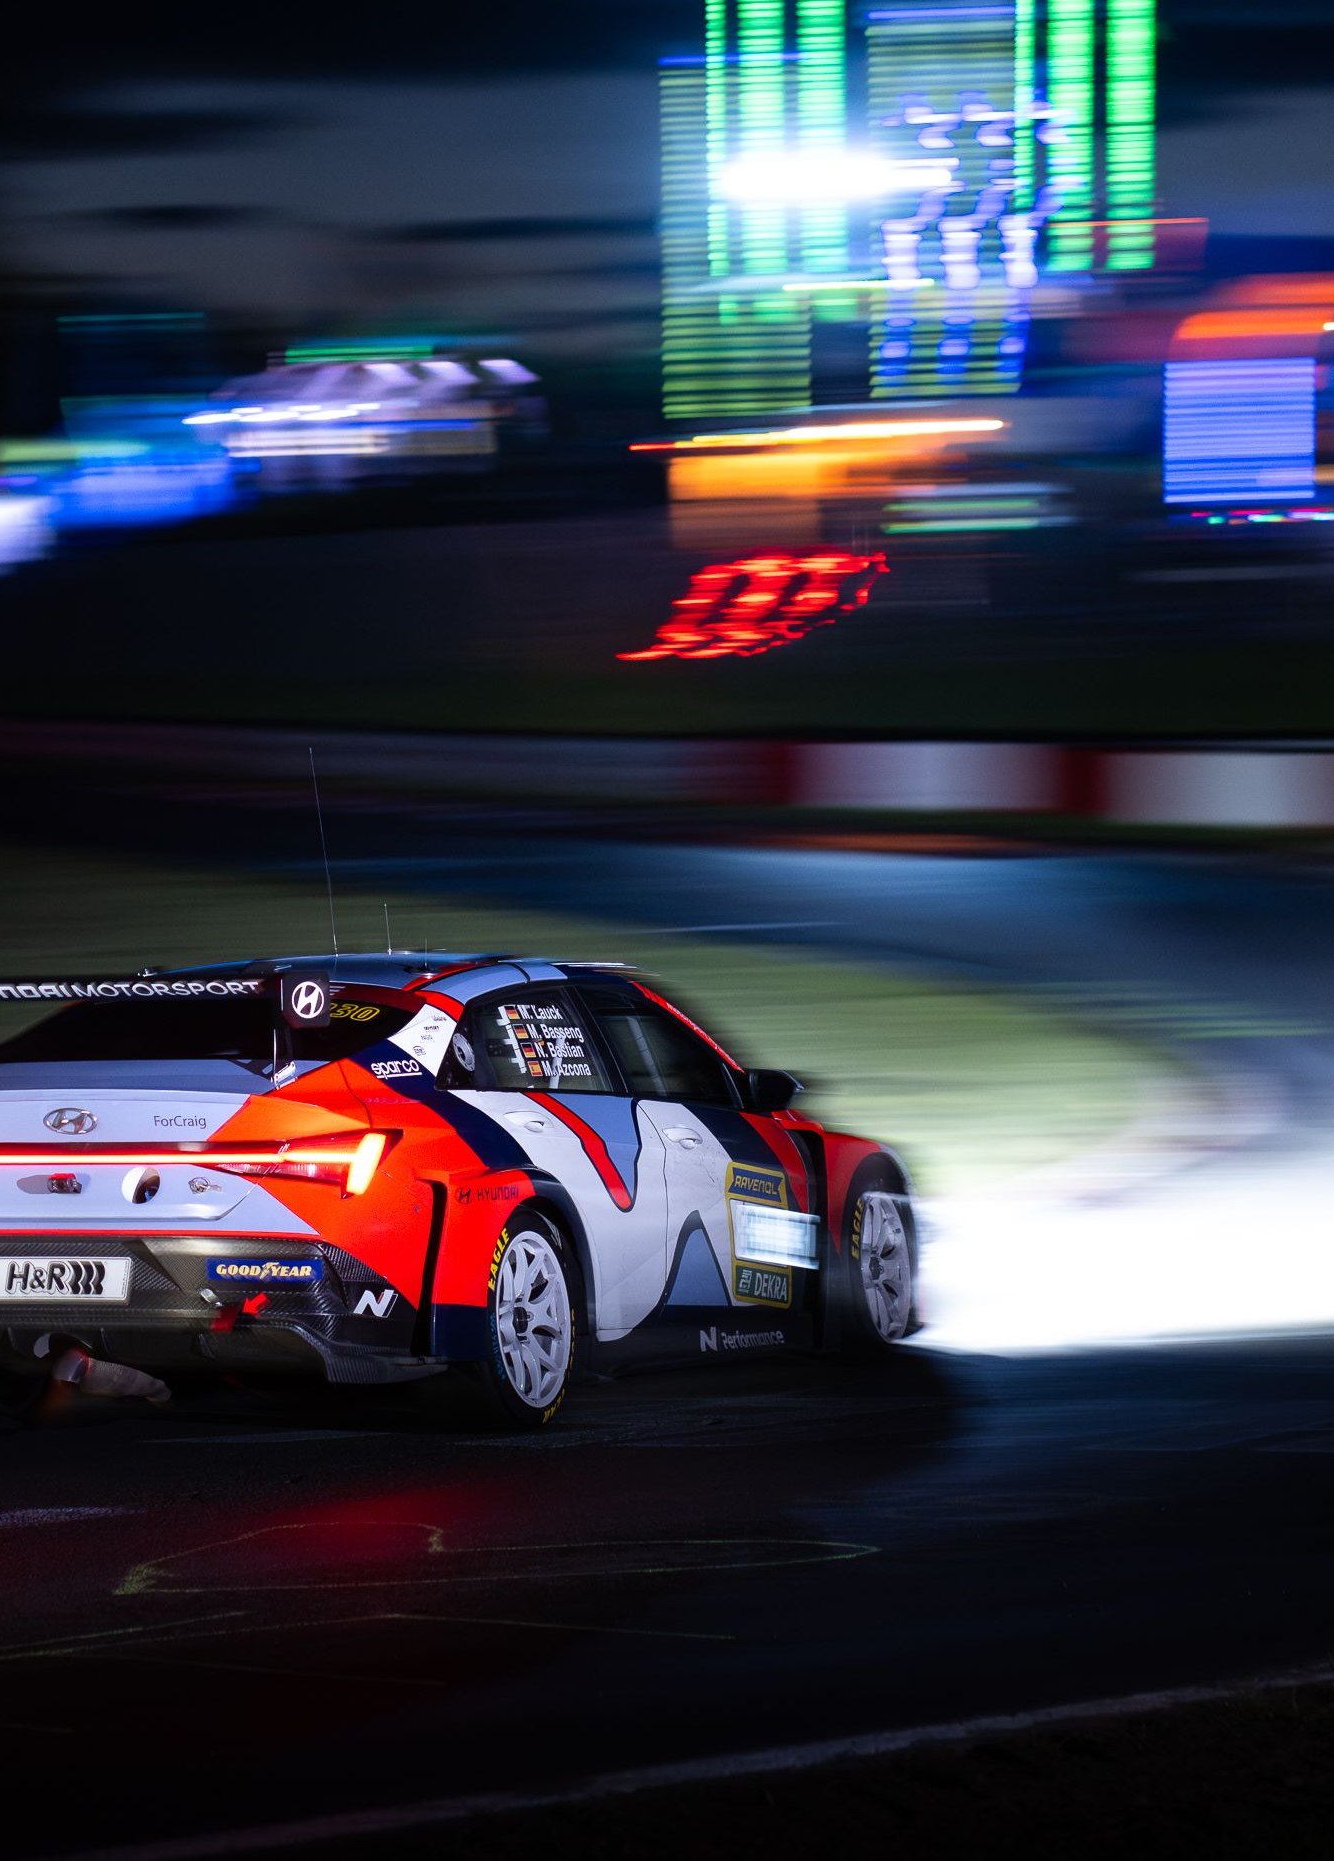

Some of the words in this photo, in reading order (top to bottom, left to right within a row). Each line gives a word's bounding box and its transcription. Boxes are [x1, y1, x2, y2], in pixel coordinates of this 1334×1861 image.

[71, 980, 259, 997] MOTORSPORT
[329, 1003, 381, 1021] 30
[516, 1004, 533, 1019] M.
[531, 1004, 563, 1019] Lauck
[526, 1023, 542, 1039] M.
[540, 1023, 584, 1043] Basseng
[534, 1041, 548, 1058] N.
[547, 1041, 584, 1058] Bastian
[371, 1059, 420, 1079] sparco
[557, 1061, 591, 1076] Azcona
[154, 1116, 207, 1129] ForCraig
[477, 1186, 519, 1200] HYUNDAI
[734, 1175, 778, 1195] RAVENOL
[851, 1197, 865, 1261] EAGLE
[487, 1227, 510, 1292] EAGLE
[5, 1261, 68, 1294] H&R
[216, 1261, 312, 1281] GOODYEAR
[753, 1272, 788, 1300] DEKRA
